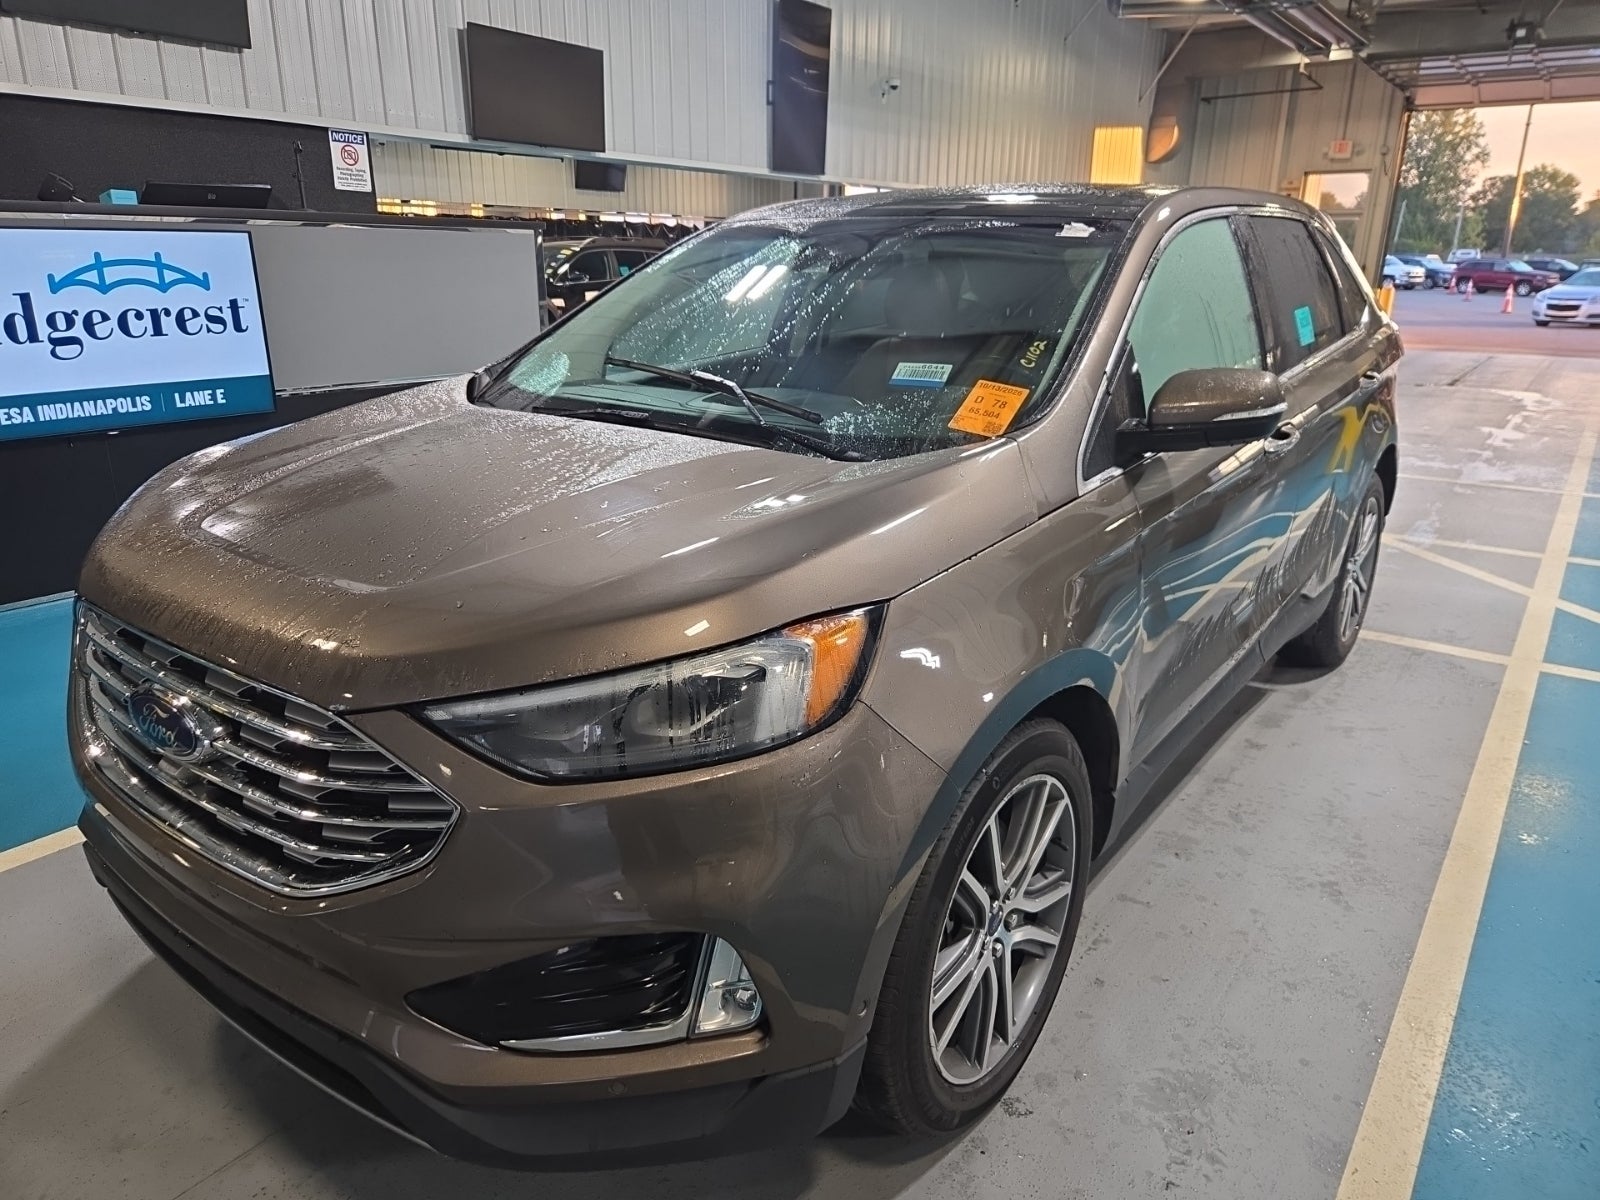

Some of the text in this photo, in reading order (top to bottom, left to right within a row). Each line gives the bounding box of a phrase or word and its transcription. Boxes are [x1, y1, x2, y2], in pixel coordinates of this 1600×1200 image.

[332, 132, 363, 144] NOTICE
[0, 292, 249, 361] dgecrest
[38, 395, 152, 422] INDIANAPOLIS
[174, 389, 214, 408] LANE
[216, 388, 226, 404] E
[992, 398, 1008, 409] 78
[140, 703, 180, 748] Ford
